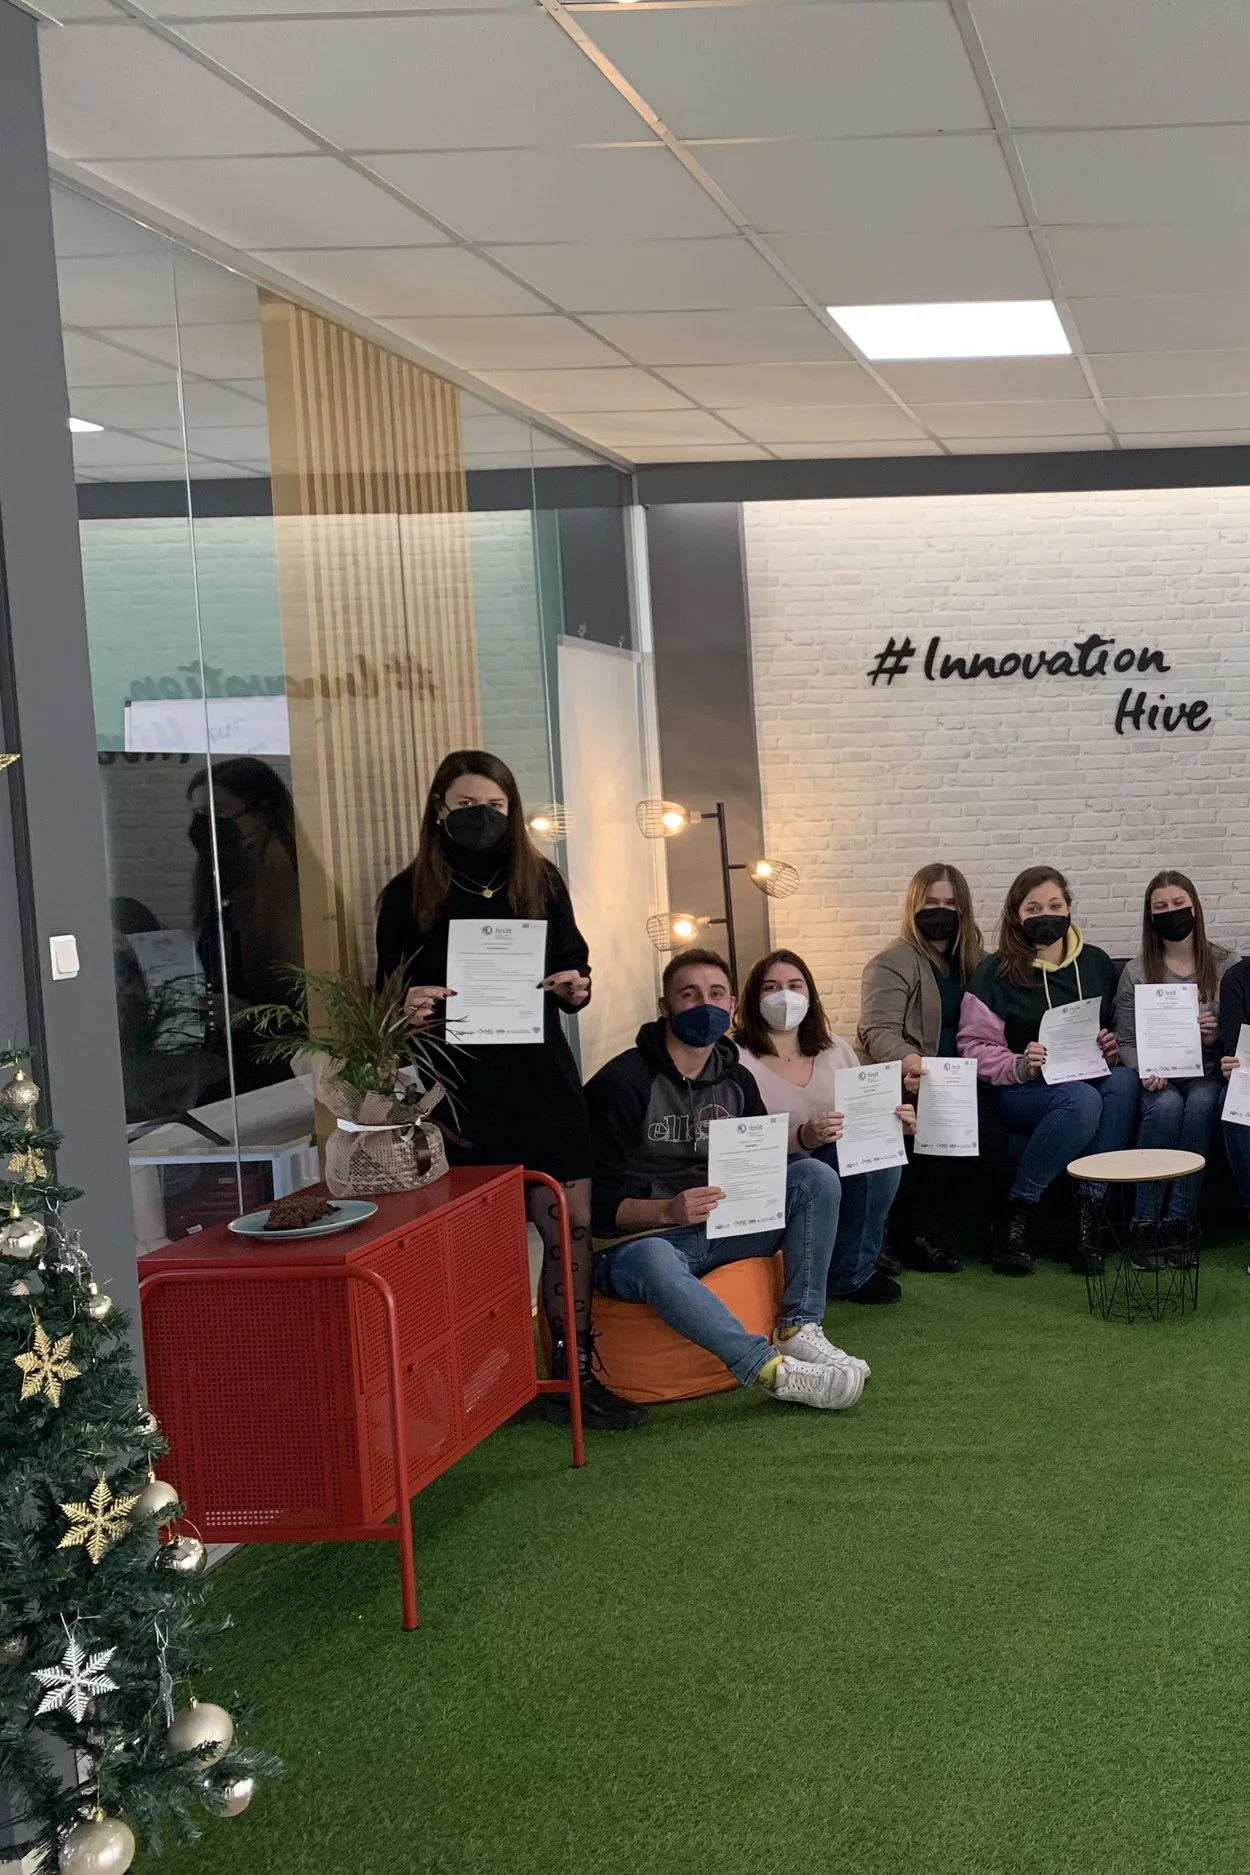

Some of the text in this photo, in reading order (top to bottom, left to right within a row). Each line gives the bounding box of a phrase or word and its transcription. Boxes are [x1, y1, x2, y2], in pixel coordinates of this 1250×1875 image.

[867, 633, 1170, 686] #Innovation
[1115, 687, 1212, 735] Hive
[647, 1114, 709, 1142] elles
